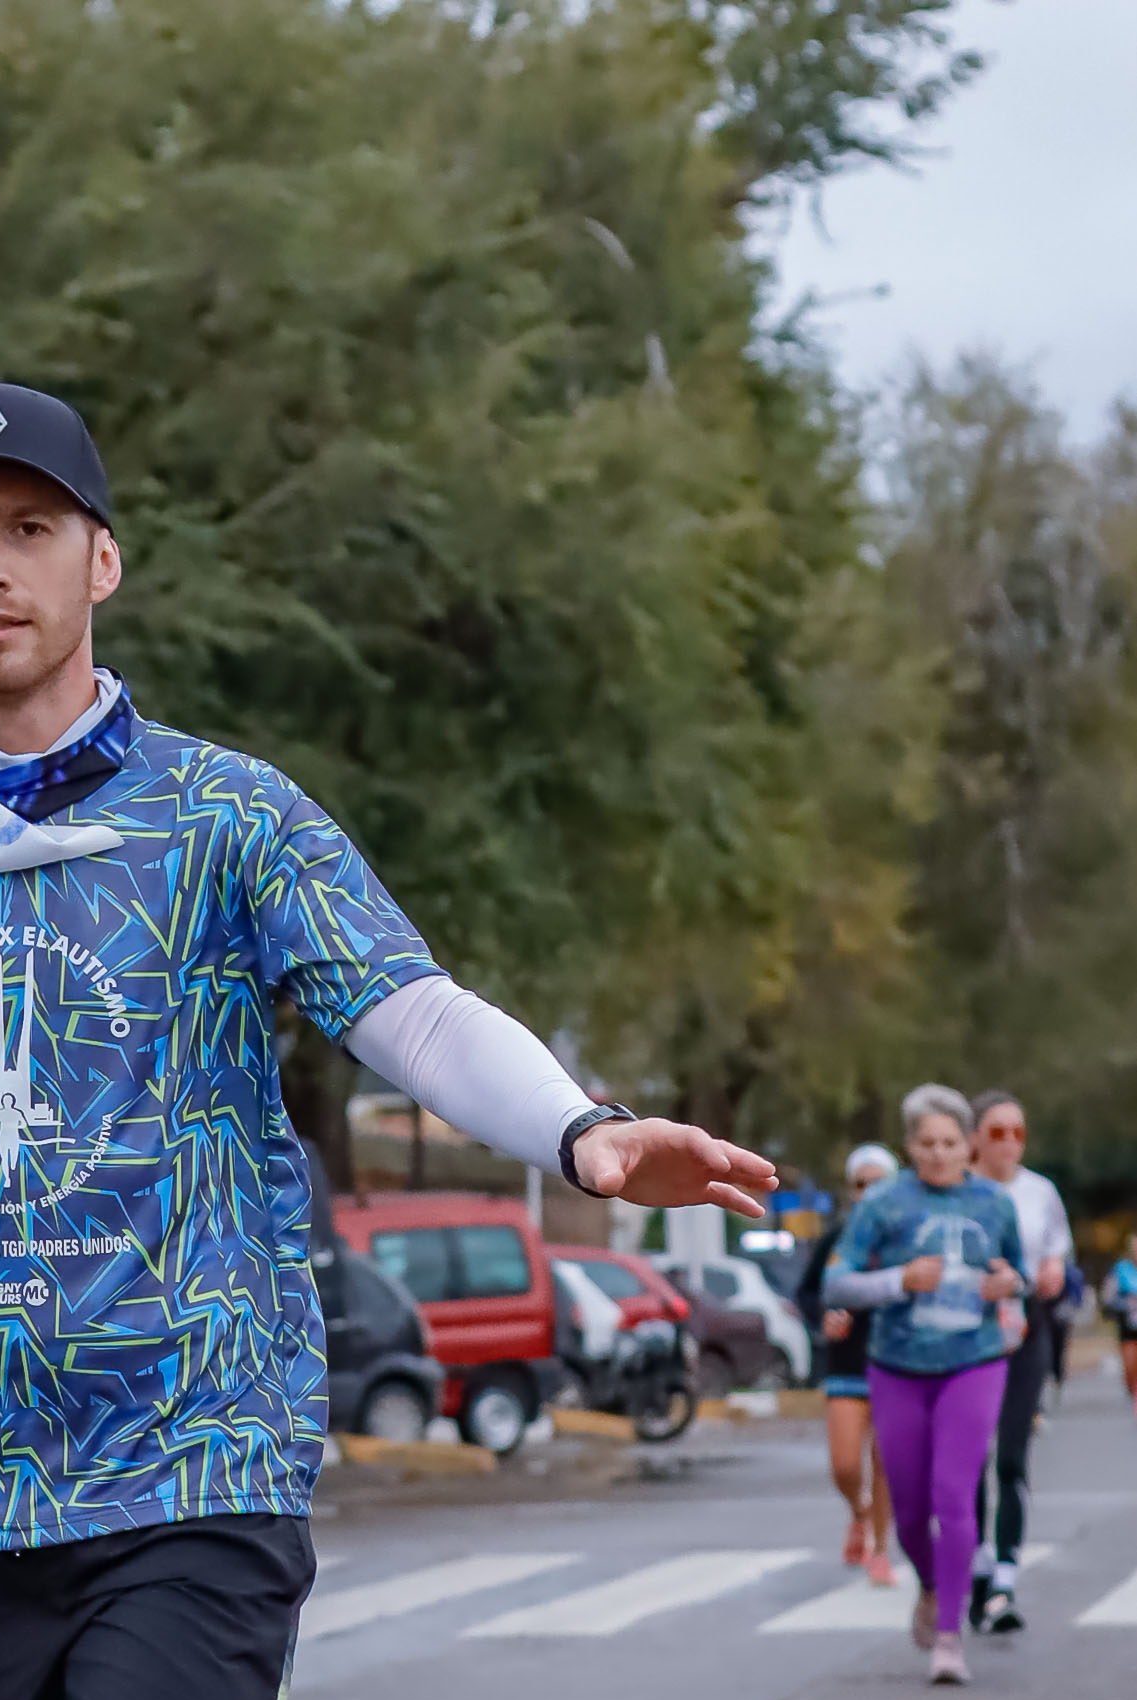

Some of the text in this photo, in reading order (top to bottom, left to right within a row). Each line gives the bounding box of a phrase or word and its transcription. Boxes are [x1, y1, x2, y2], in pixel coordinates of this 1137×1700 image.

[49, 935, 131, 1038] AUTISMO
[27, 1200, 37, 1212] Y
[39, 1170, 91, 1208] ENERGÍA
[85, 1113, 114, 1172] POSITIVA
[1, 1240, 27, 1258] TGD
[29, 1238, 80, 1258] PADRES
[82, 1235, 132, 1254] UNIDOS
